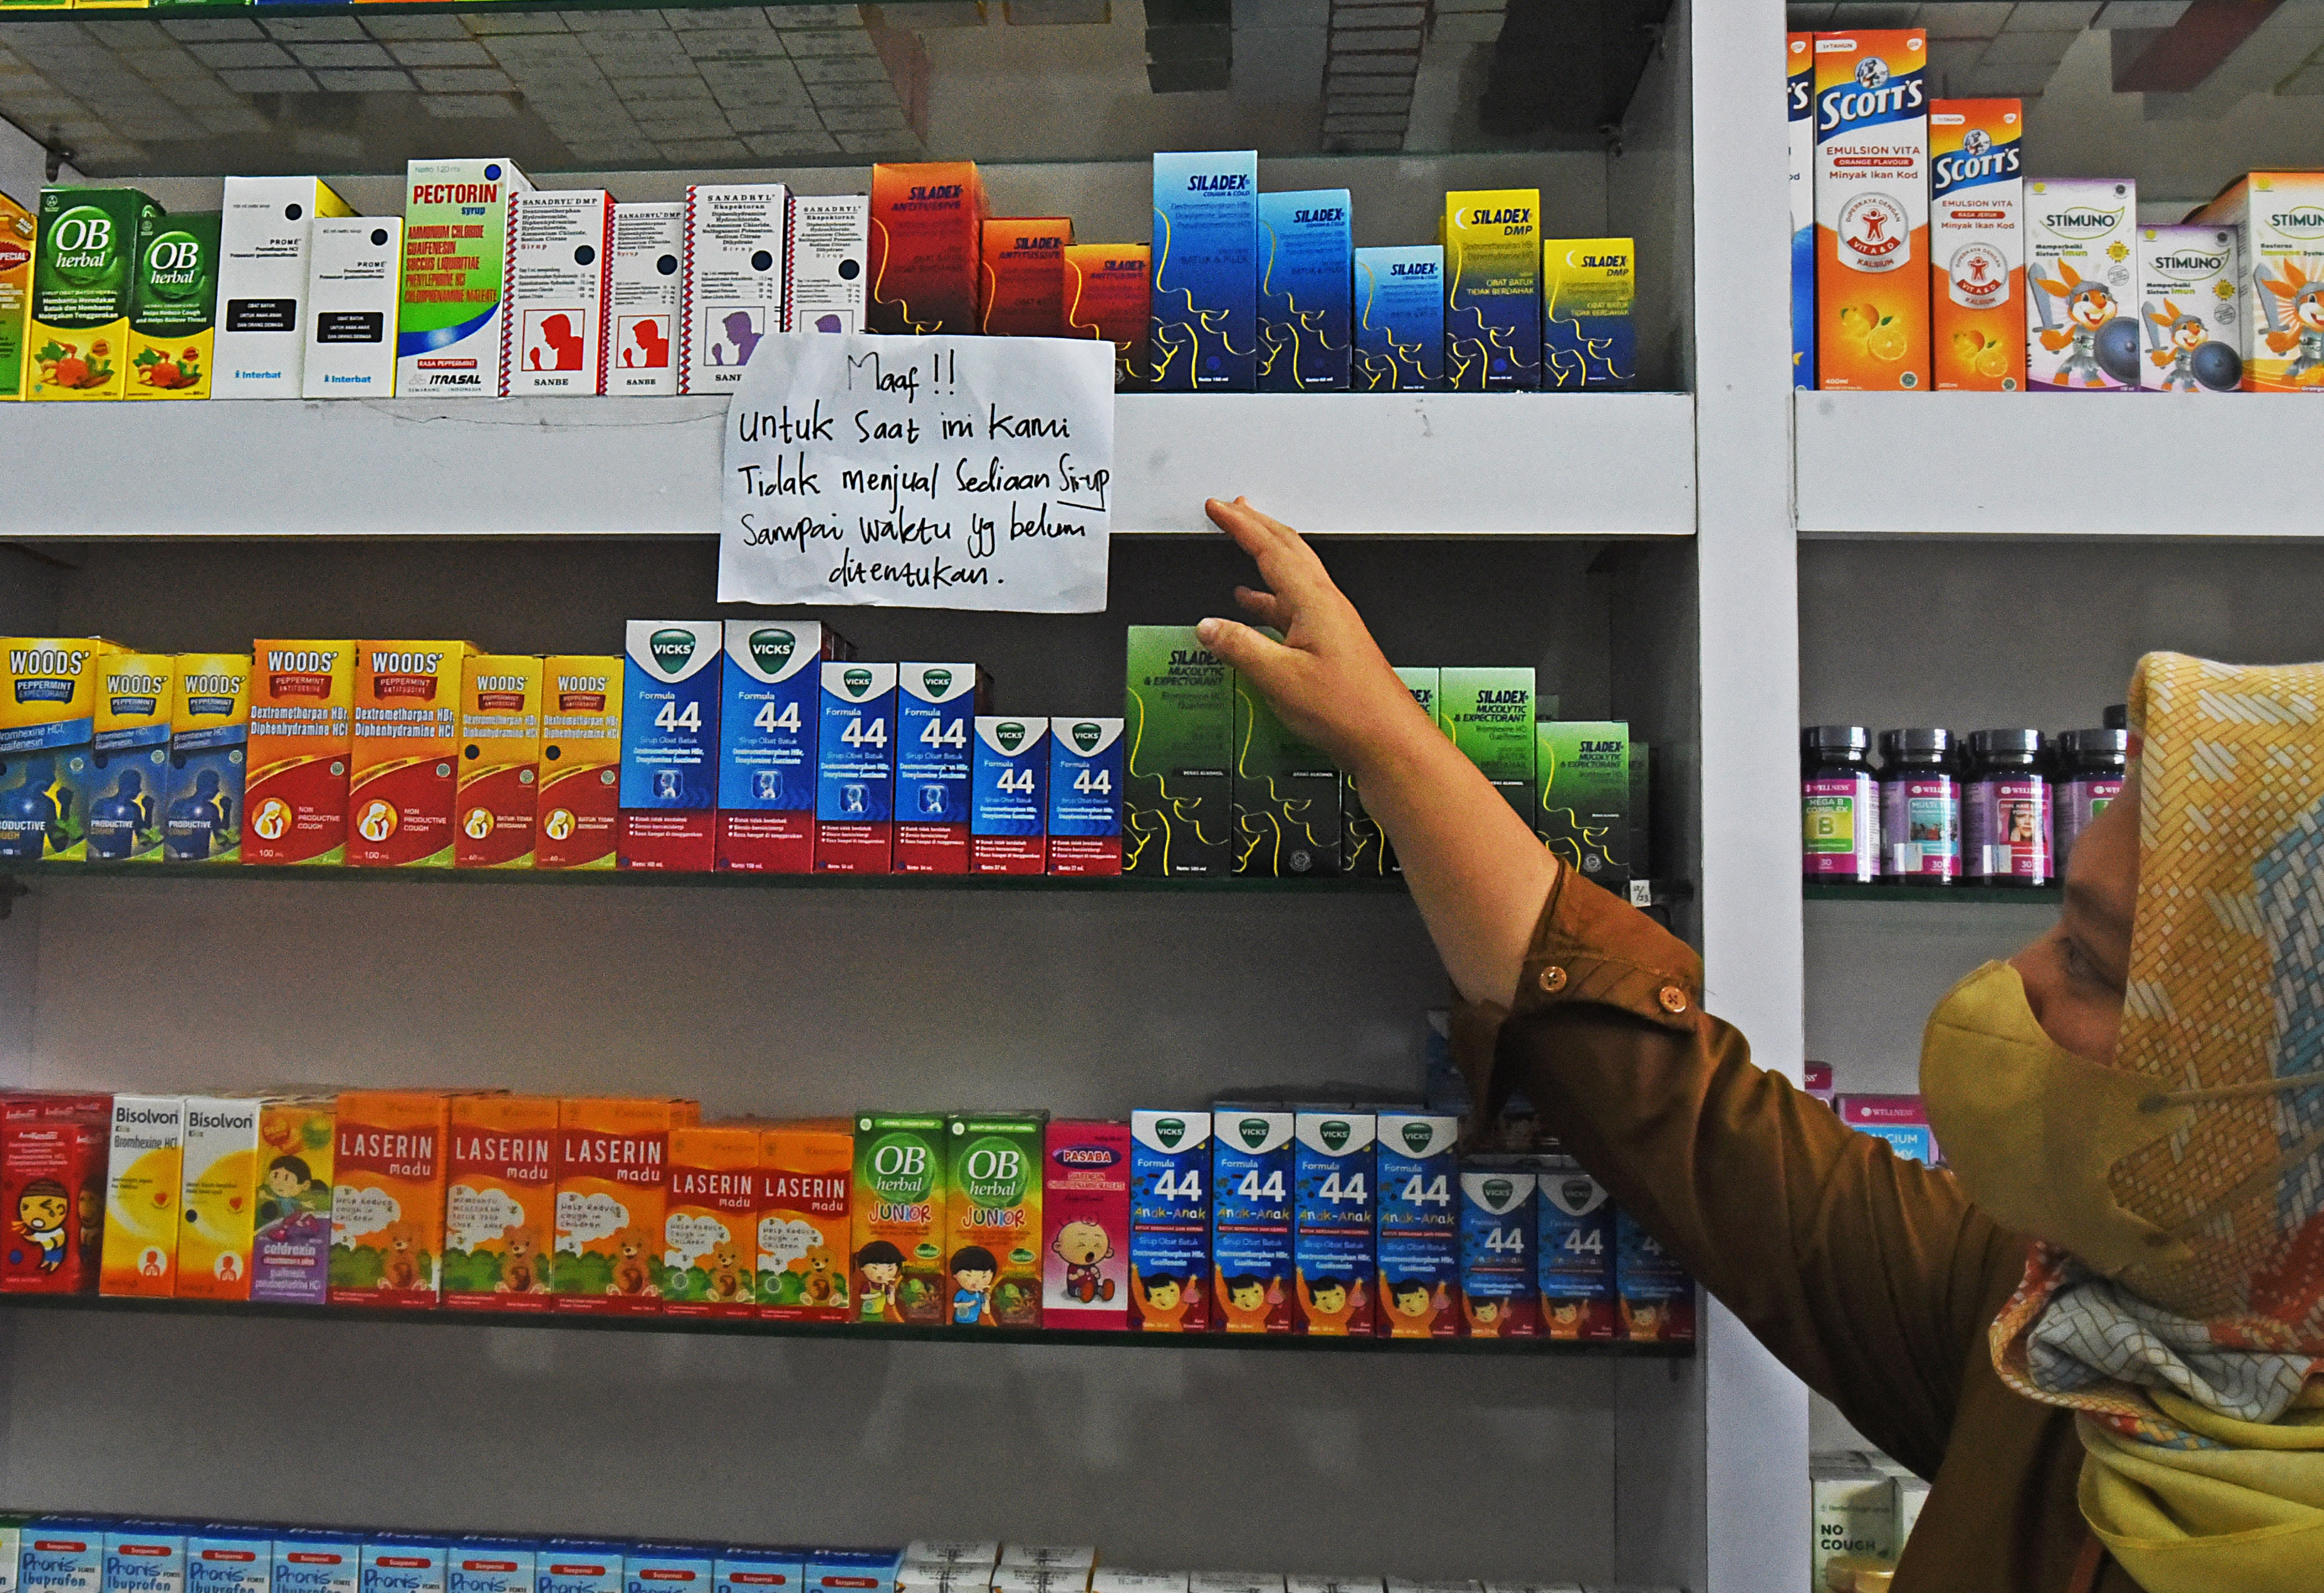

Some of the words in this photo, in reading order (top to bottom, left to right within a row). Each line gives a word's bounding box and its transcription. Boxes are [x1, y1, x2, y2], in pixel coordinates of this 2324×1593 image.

[1820, 79, 1923, 131] SCOTT'S
[1827, 146, 1889, 155] EMULSION
[1893, 146, 1920, 155] VITA
[1830, 171, 1868, 180] Minyak
[1897, 171, 1918, 179] Kod
[1936, 149, 2020, 189] SCOTT'S
[1188, 175, 1247, 190] SILADEX
[413, 184, 497, 204] PECTORIN
[909, 186, 961, 200] SILADEX
[461, 207, 485, 215] syrup
[1294, 209, 1343, 223] SILADEX
[1472, 209, 1530, 224] SILADEX
[1845, 198, 1877, 223] DIPERKAYA
[1878, 199, 1900, 223] DENGAN
[2047, 215, 2115, 227] STIMUNO
[56, 220, 110, 250] OB
[1504, 226, 1533, 235] DMP
[1014, 238, 1060, 249] SILADEX
[1853, 242, 1870, 254] VIT
[1879, 246, 1886, 254] &
[1887, 242, 1894, 251] D
[56, 252, 105, 267] herbal
[150, 242, 198, 269] OB
[1581, 256, 1626, 267] SILADEX
[1857, 258, 1894, 268] KALSIUM
[2156, 257, 2221, 269] STIMUNO
[1104, 261, 1144, 271] SILADEX
[1391, 263, 1436, 276] SILADEX
[151, 271, 193, 284] herbal
[430, 375, 481, 385] ITRASAL
[848, 353, 918, 403] Maaf
[740, 400, 834, 444] Untuk
[942, 413, 972, 440] ini
[738, 452, 820, 497] Tidak
[844, 464, 937, 514] menjual
[956, 458, 1049, 492] Sediaan
[1059, 453, 1109, 507] Sirup
[741, 513, 843, 552] Sampai
[969, 512, 995, 558] yg
[1010, 502, 1085, 540] belum
[829, 548, 1003, 589] ditentukan.
[654, 644, 691, 654] VICKS
[753, 645, 790, 654] VICKS
[10, 651, 90, 674] WOODS'
[268, 651, 338, 672] WOODS'
[372, 652, 443, 673] WOODS'
[17, 682, 71, 690] PEPPERMINT
[106, 676, 167, 693] WOODS'
[185, 676, 245, 693] WOODS'
[477, 676, 529, 691] WOODS'
[558, 676, 609, 691] WOODS'
[738, 692, 775, 700] Formula
[1476, 691, 1526, 704] SILADEX
[655, 702, 701, 732] 44
[754, 702, 801, 733] 44
[841, 718, 887, 748] 44
[920, 718, 966, 748] 44
[1580, 741, 1622, 752] SILADEX
[997, 769, 1035, 794] 44
[1074, 770, 1111, 794] 44
[1819, 817, 1834, 835] B
[116, 1107, 178, 1124] Bisolvon
[189, 1113, 253, 1129] Bisolvon
[114, 1135, 162, 1149] Bromhexine
[341, 1133, 432, 1158] LASERIN
[456, 1138, 548, 1163] LASERIN
[565, 1139, 661, 1165] LASERIN
[1064, 1151, 1111, 1163] PASABA
[875, 1146, 926, 1176] OB
[967, 1150, 1019, 1180] OB
[1138, 1159, 1175, 1167] Formula
[390, 1163, 431, 1176] madu
[507, 1167, 548, 1179] madu
[617, 1168, 661, 1182] madu
[673, 1174, 752, 1194] LASERIN
[766, 1178, 844, 1198] LASERIN
[877, 1176, 922, 1192] herbal
[970, 1181, 1016, 1196] herbal
[1154, 1169, 1202, 1202] 44
[1238, 1169, 1286, 1202] 44
[1319, 1172, 1367, 1204] 44
[720, 1197, 750, 1207] madu
[812, 1201, 843, 1211] madu
[869, 1202, 931, 1224] JUNIOR
[962, 1207, 1025, 1228] JUNIOR
[1134, 1208, 1206, 1219] Anak-Anak
[1821, 1524, 1843, 1535] NO
[1821, 1540, 1875, 1550] COUGH
[23, 1571, 85, 1588] Ibuprofen
